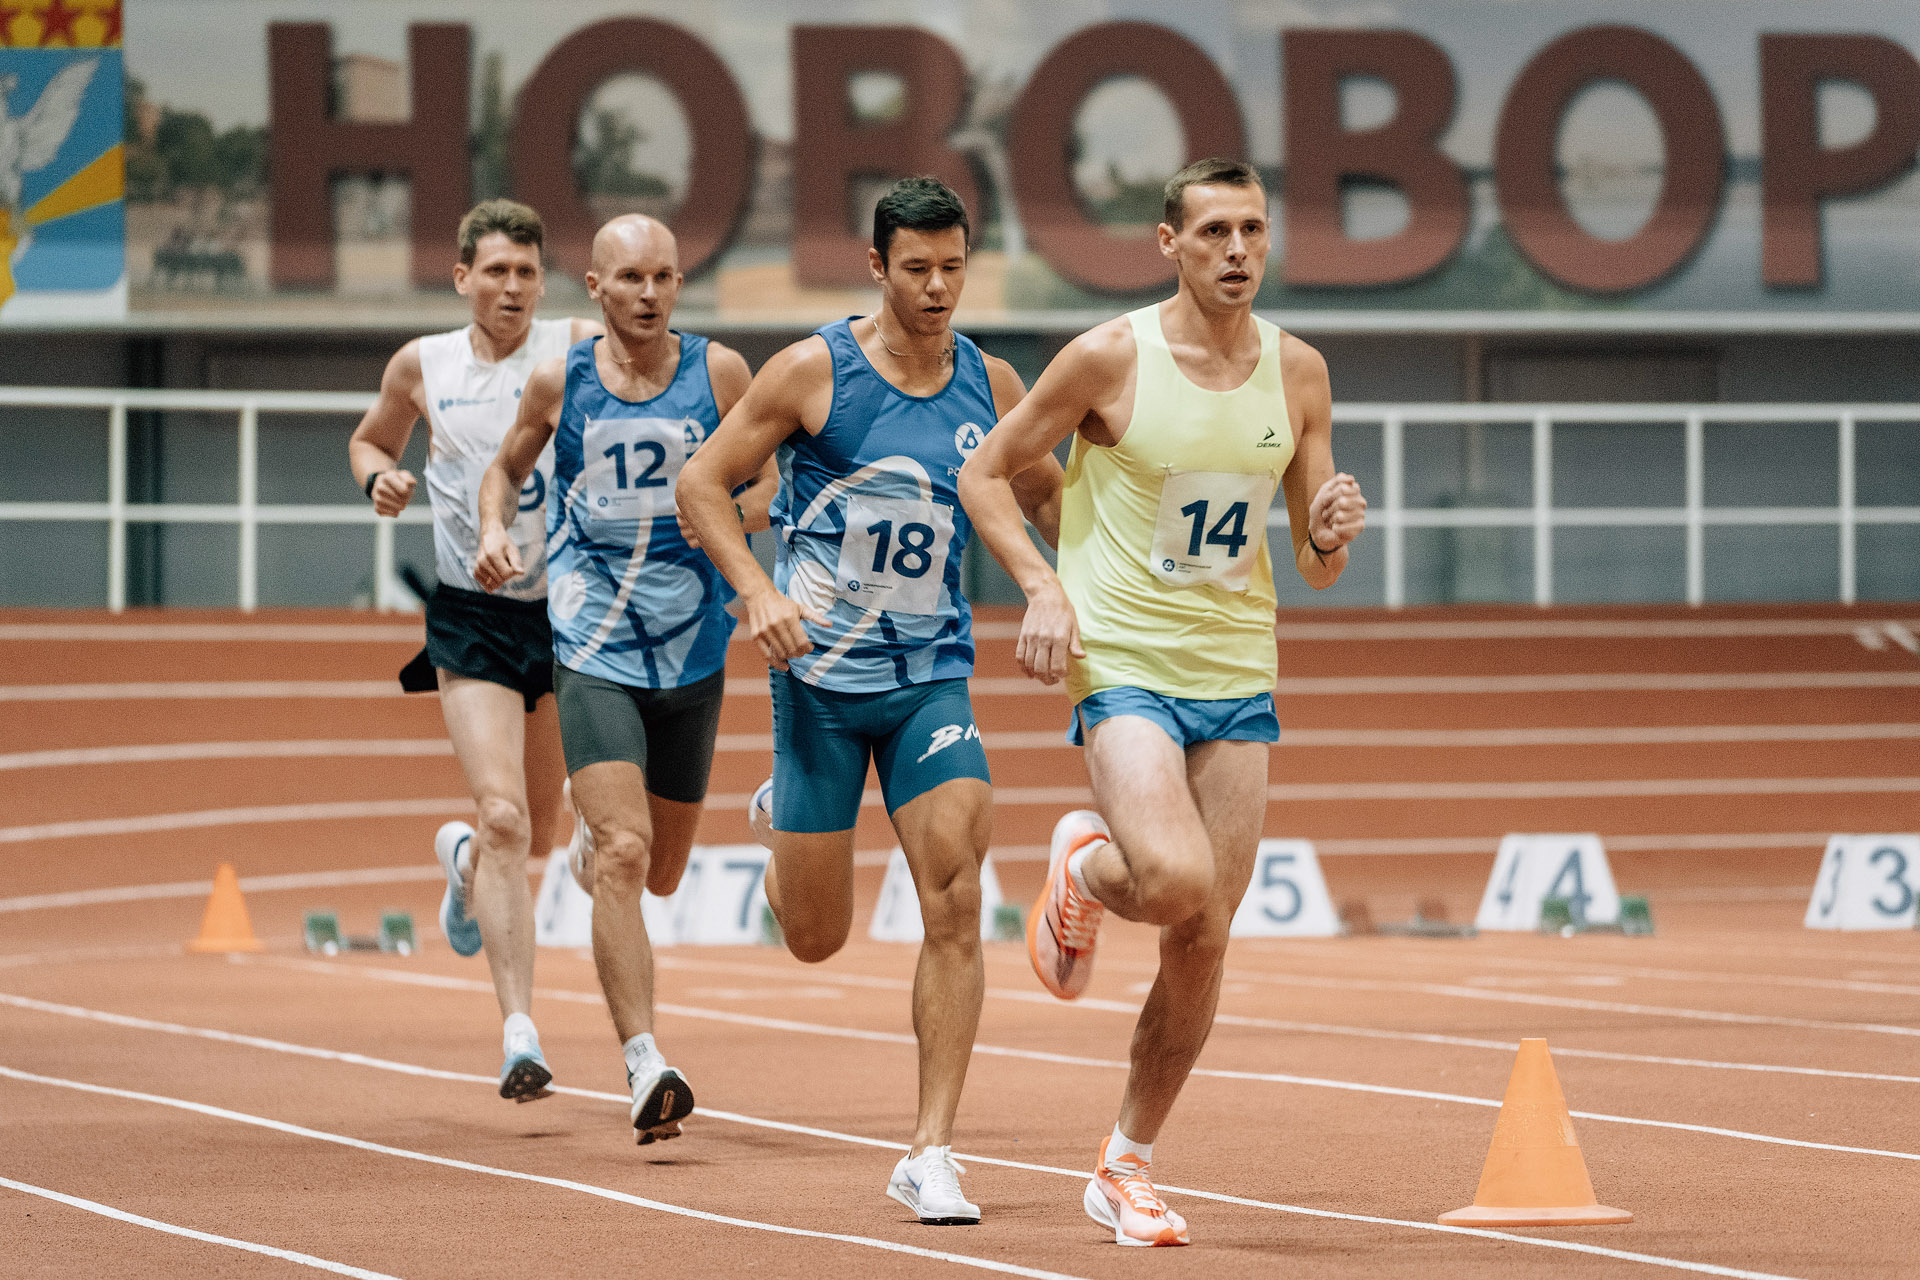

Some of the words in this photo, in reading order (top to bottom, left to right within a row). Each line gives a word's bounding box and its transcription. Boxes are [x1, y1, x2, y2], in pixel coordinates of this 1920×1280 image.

[603, 440, 668, 489] 12
[866, 519, 935, 579] 18
[1180, 499, 1249, 557] 14
[723, 860, 765, 930] 7
[1261, 854, 1303, 923] 5
[1545, 848, 1592, 928] 4
[1868, 846, 1913, 918] 3
